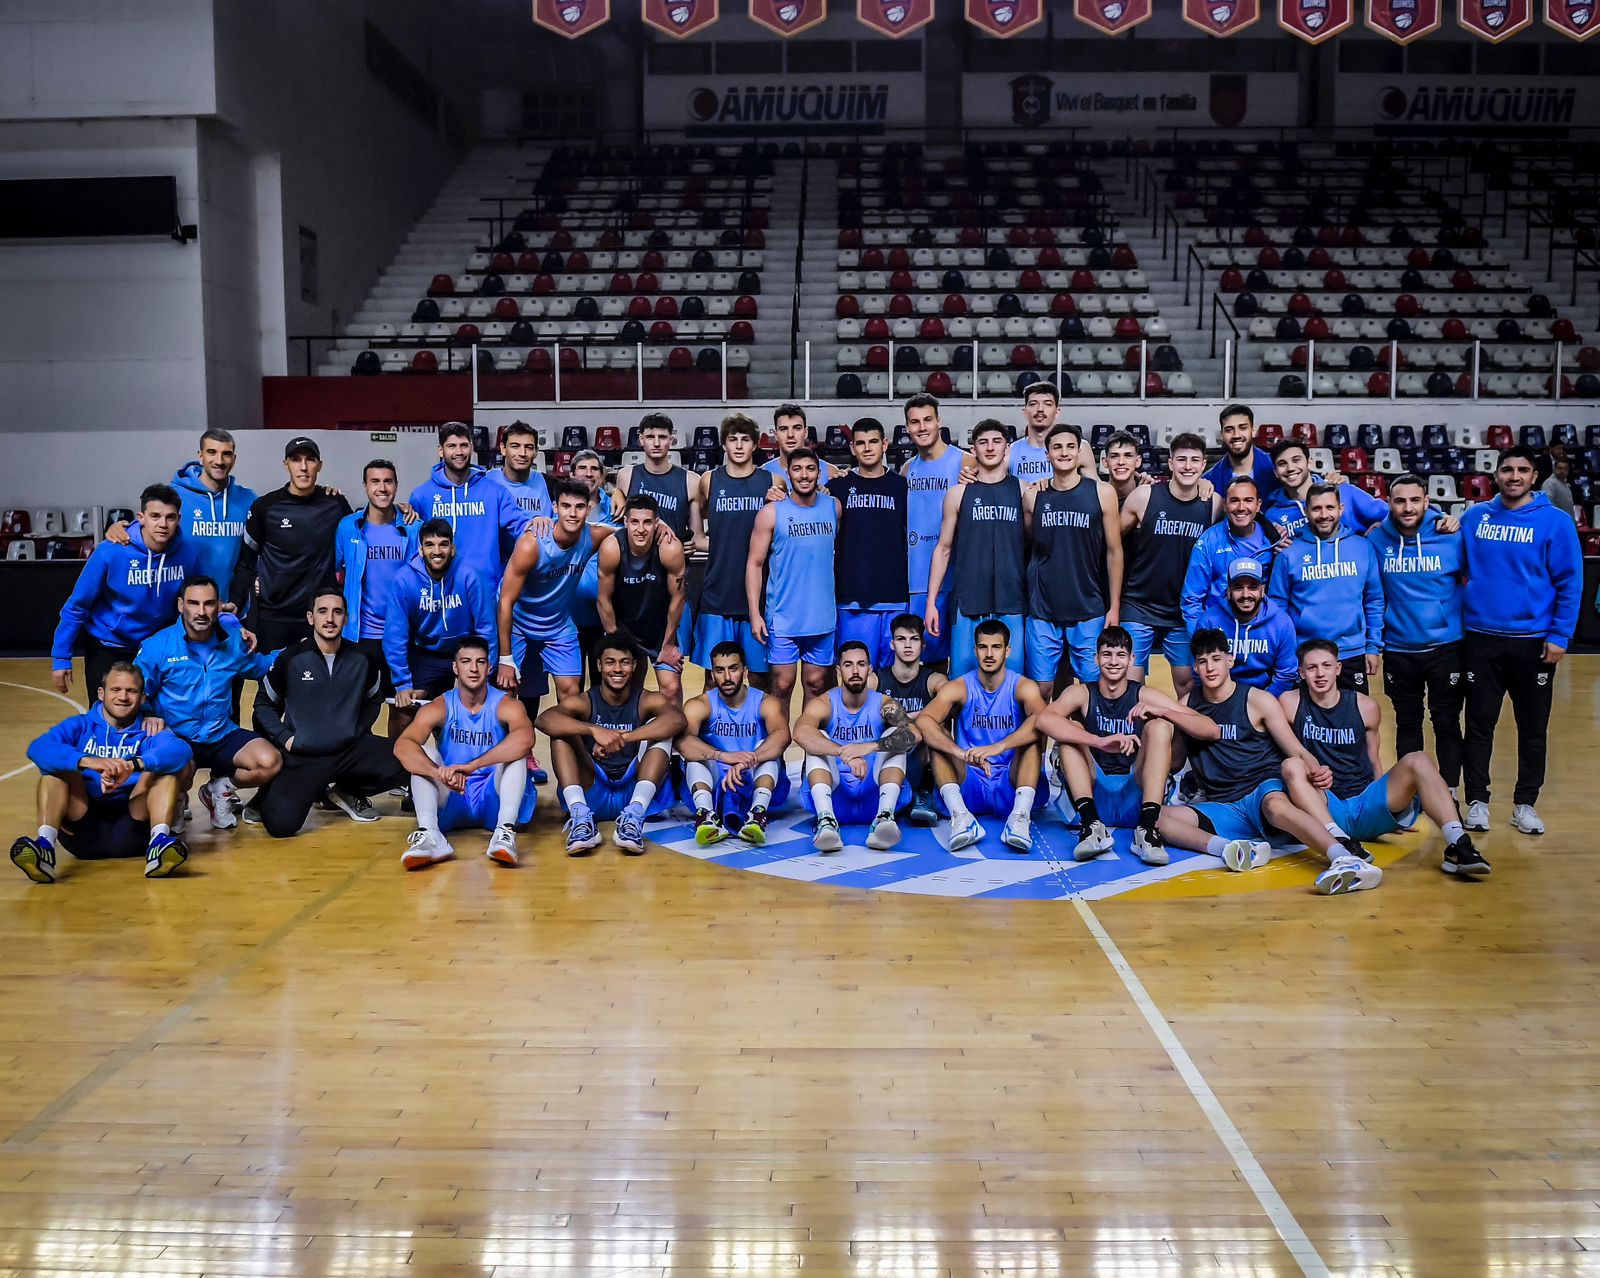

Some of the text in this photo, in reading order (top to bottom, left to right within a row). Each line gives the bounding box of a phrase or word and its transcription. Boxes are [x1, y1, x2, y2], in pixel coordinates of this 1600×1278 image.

[718, 85, 889, 121] AMUQUIM
[1406, 86, 1577, 122] AMUQUIM
[1017, 461, 1051, 476] ARGENT
[516, 498, 541, 511] NTINA
[716, 497, 764, 512] ARGENTINA
[846, 494, 895, 510] ARGENTINA
[192, 521, 245, 536] ARGENTINA
[788, 522, 834, 538] ARGENTINA
[1154, 520, 1204, 538] ARGENTINA
[1476, 523, 1534, 543] ARGENTINA
[367, 545, 404, 560] GENTIN
[1302, 561, 1358, 581] ARGENTINA
[1384, 556, 1441, 572] ARGENTINA
[419, 594, 463, 612] ARENINA
[1227, 638, 1269, 654] GNTINA
[714, 722, 757, 738] RGENTNA
[971, 714, 1014, 730] ARGNTINA
[832, 725, 874, 740] AGENTINA
[1303, 722, 1356, 745] ARGENTINA
